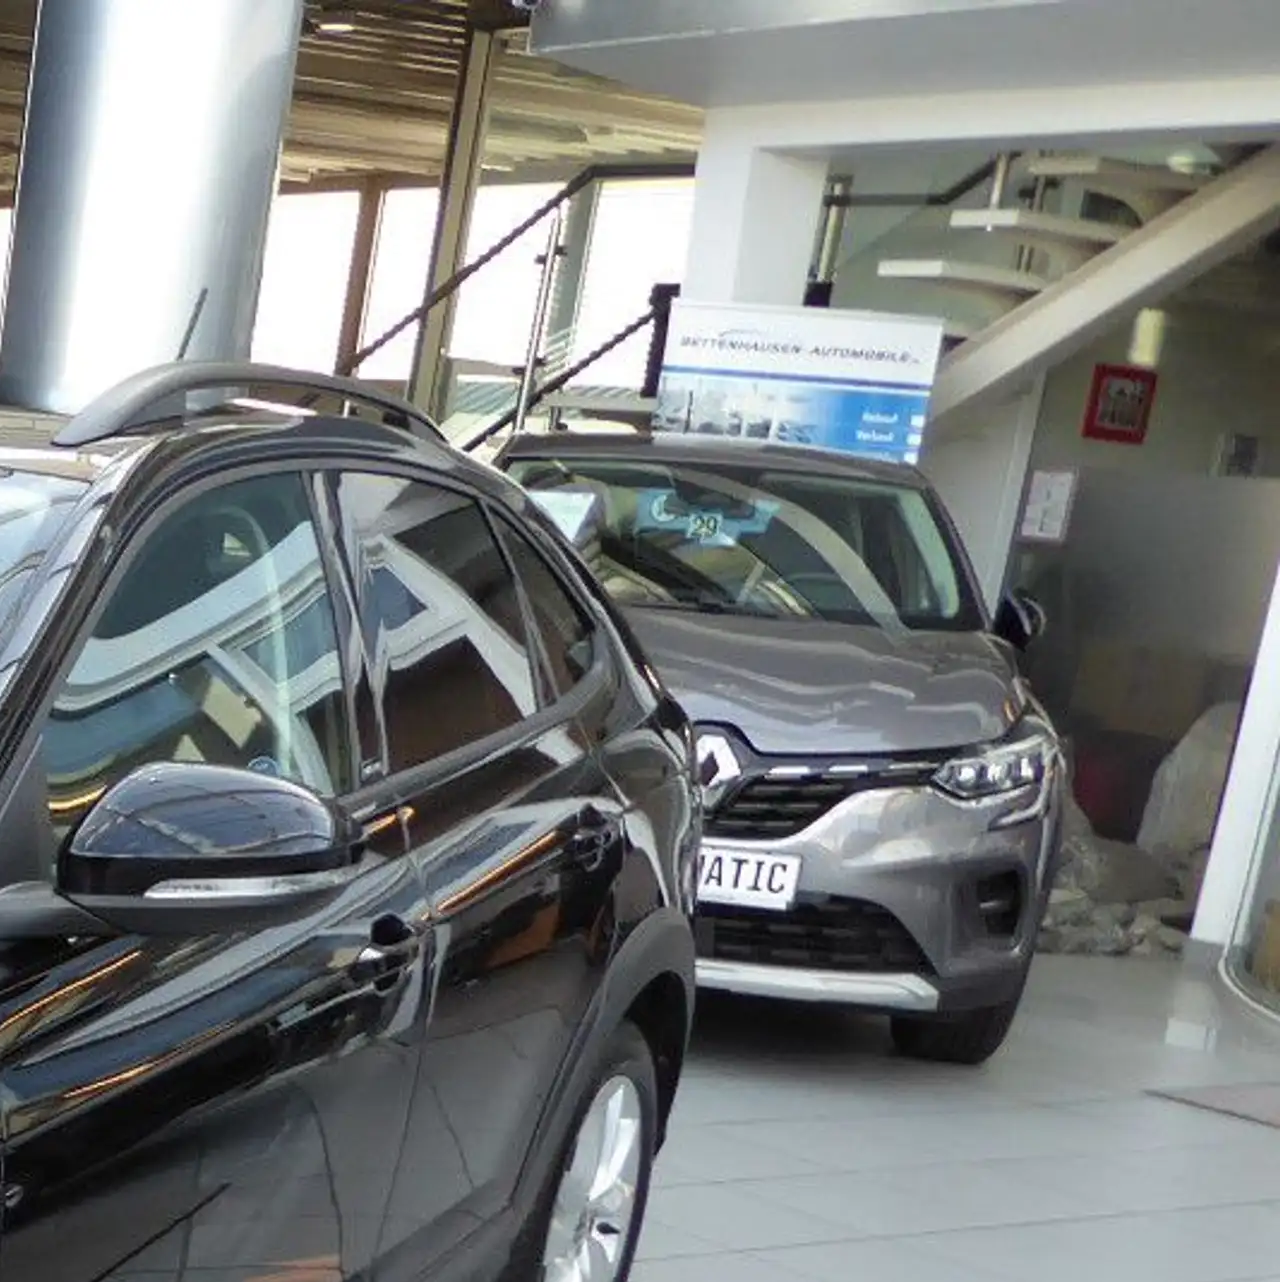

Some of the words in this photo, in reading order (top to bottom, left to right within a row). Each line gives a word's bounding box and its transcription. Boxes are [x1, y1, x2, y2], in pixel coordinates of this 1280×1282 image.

[680, 338, 801, 354] BETTENHAUSEN
[810, 346, 910, 364] AUTOMOBILE
[699, 854, 788, 893] ATIC
